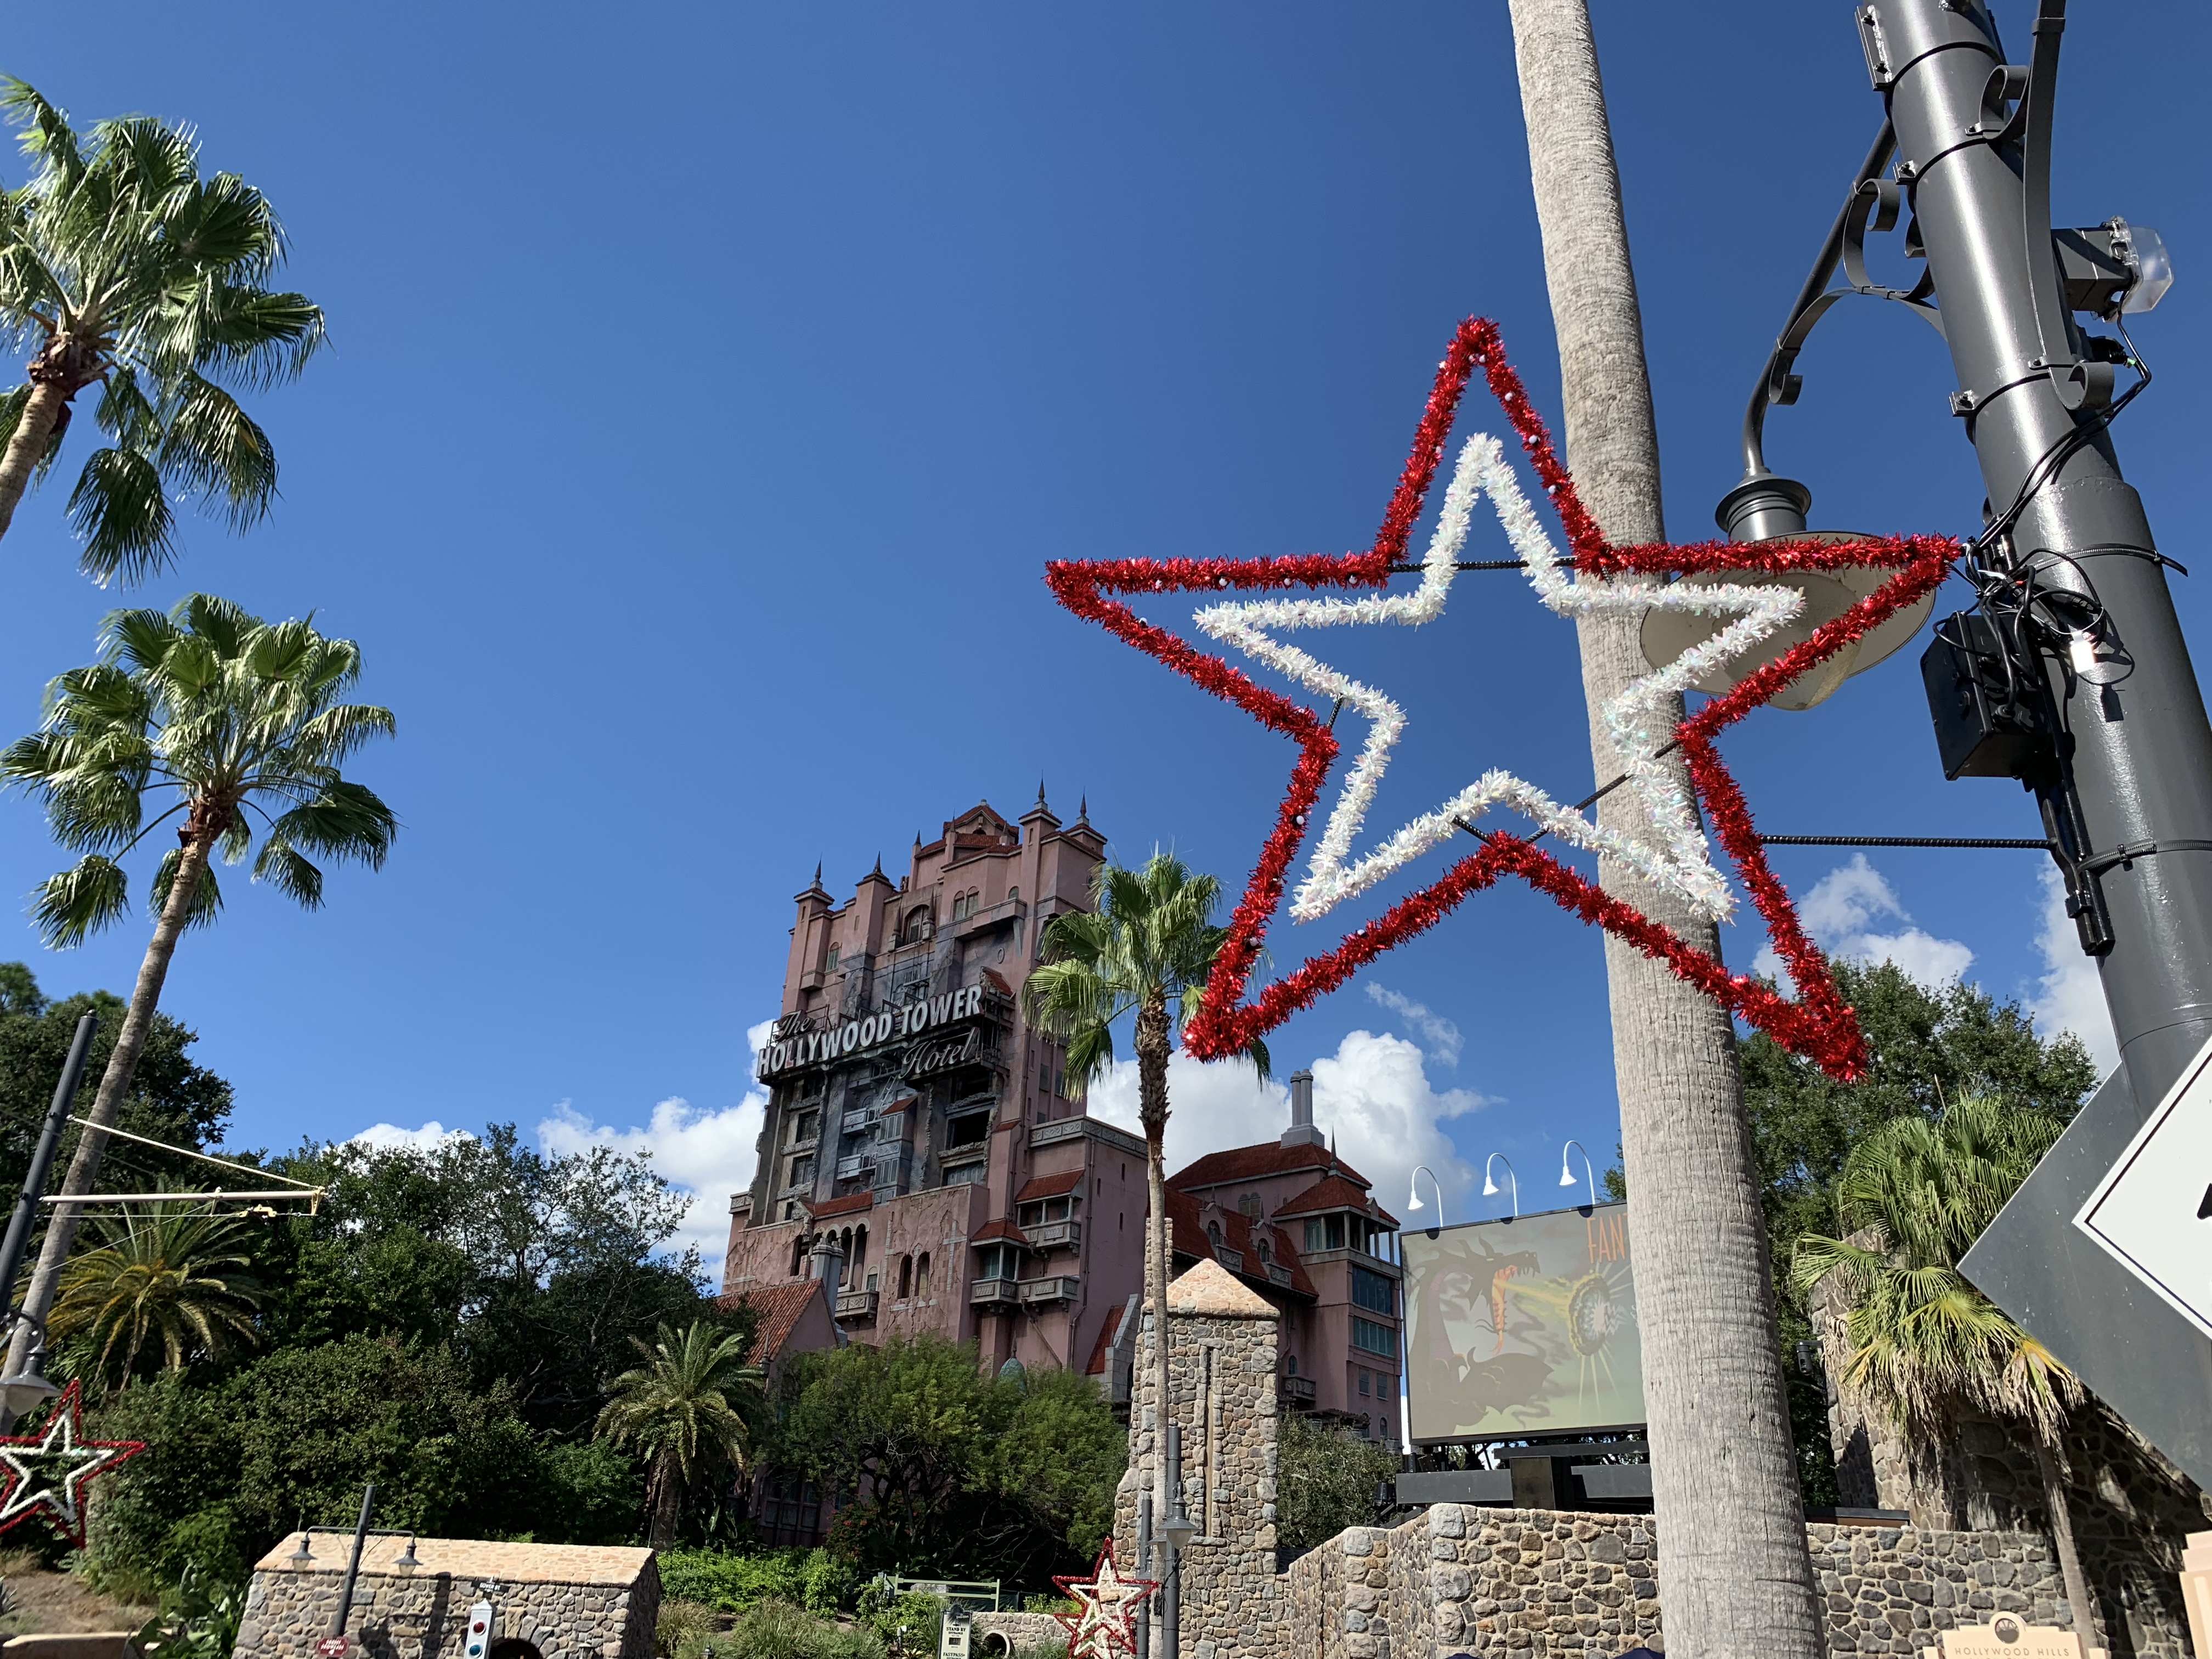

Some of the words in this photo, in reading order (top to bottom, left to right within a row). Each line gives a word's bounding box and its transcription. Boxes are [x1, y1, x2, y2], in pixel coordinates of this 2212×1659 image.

[757, 1012, 894, 1078] HOLLYWOOD
[900, 984, 984, 1036] TOWER
[774, 1009, 815, 1041] The
[899, 1026, 980, 1080] Hotel
[1586, 1212, 1629, 1265] FAN
[1955, 1647, 2030, 1656] HOLLYWOOD
[2038, 1648, 2070, 1657] HILLS
